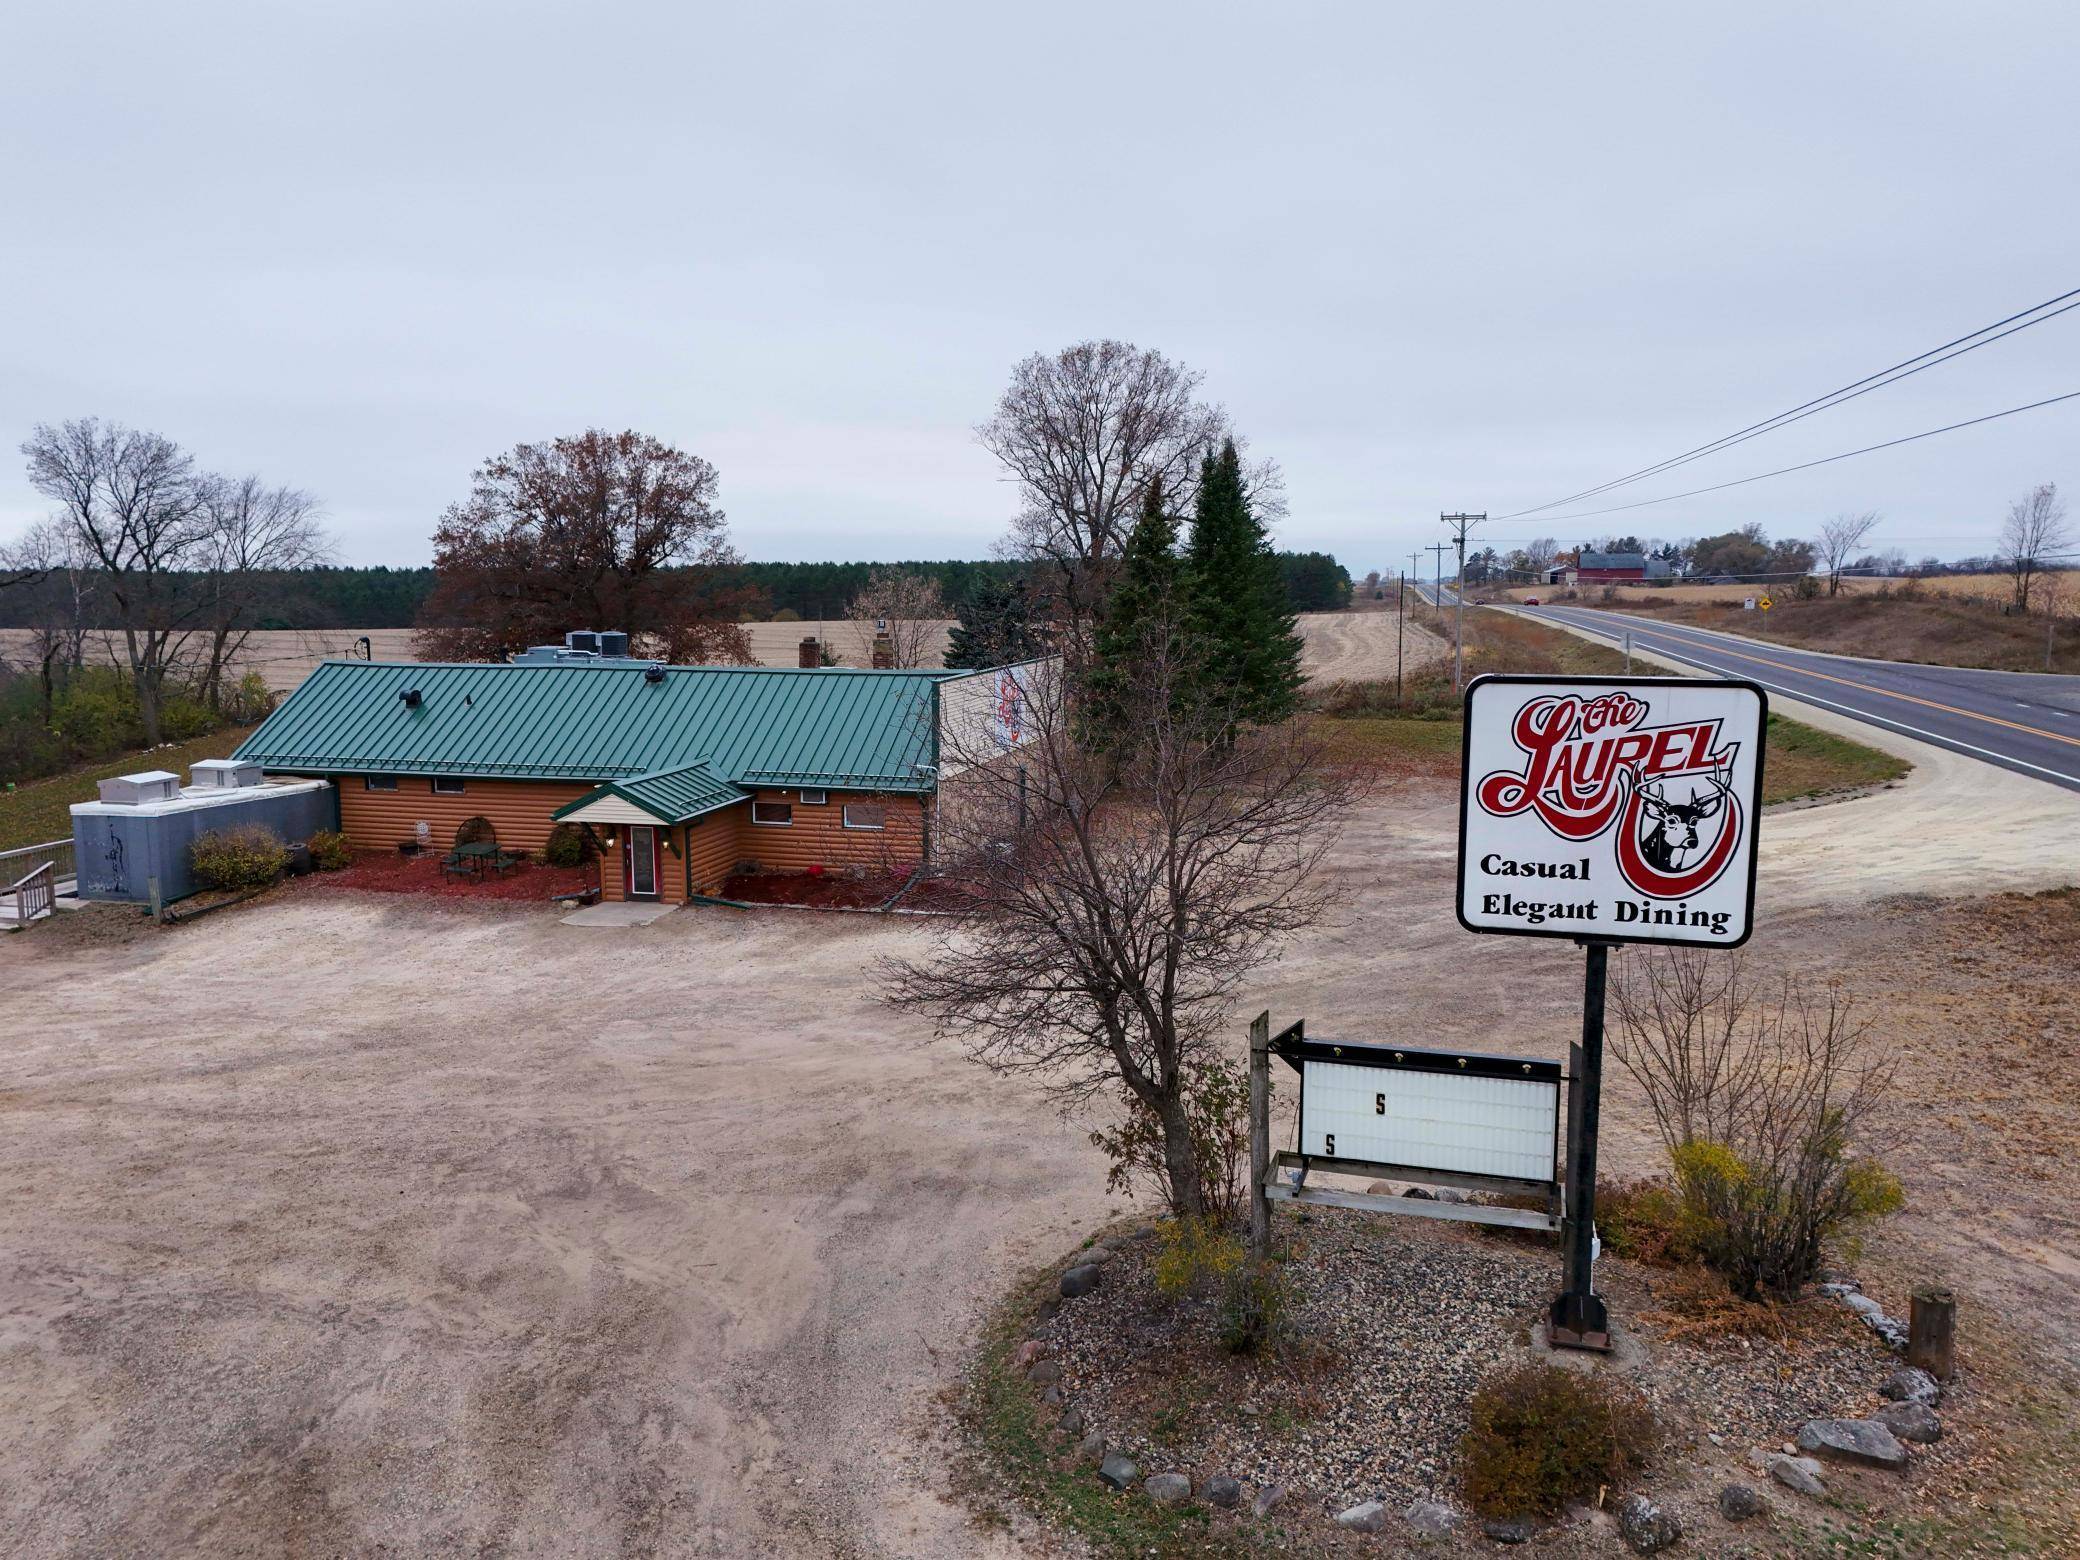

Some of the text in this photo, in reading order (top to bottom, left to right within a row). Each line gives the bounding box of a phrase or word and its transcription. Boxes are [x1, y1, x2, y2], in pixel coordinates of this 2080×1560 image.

[1480, 699, 1732, 838] LAUREL
[1480, 854, 1591, 880] Casual
[1481, 894, 1732, 934] Elegant Dining
